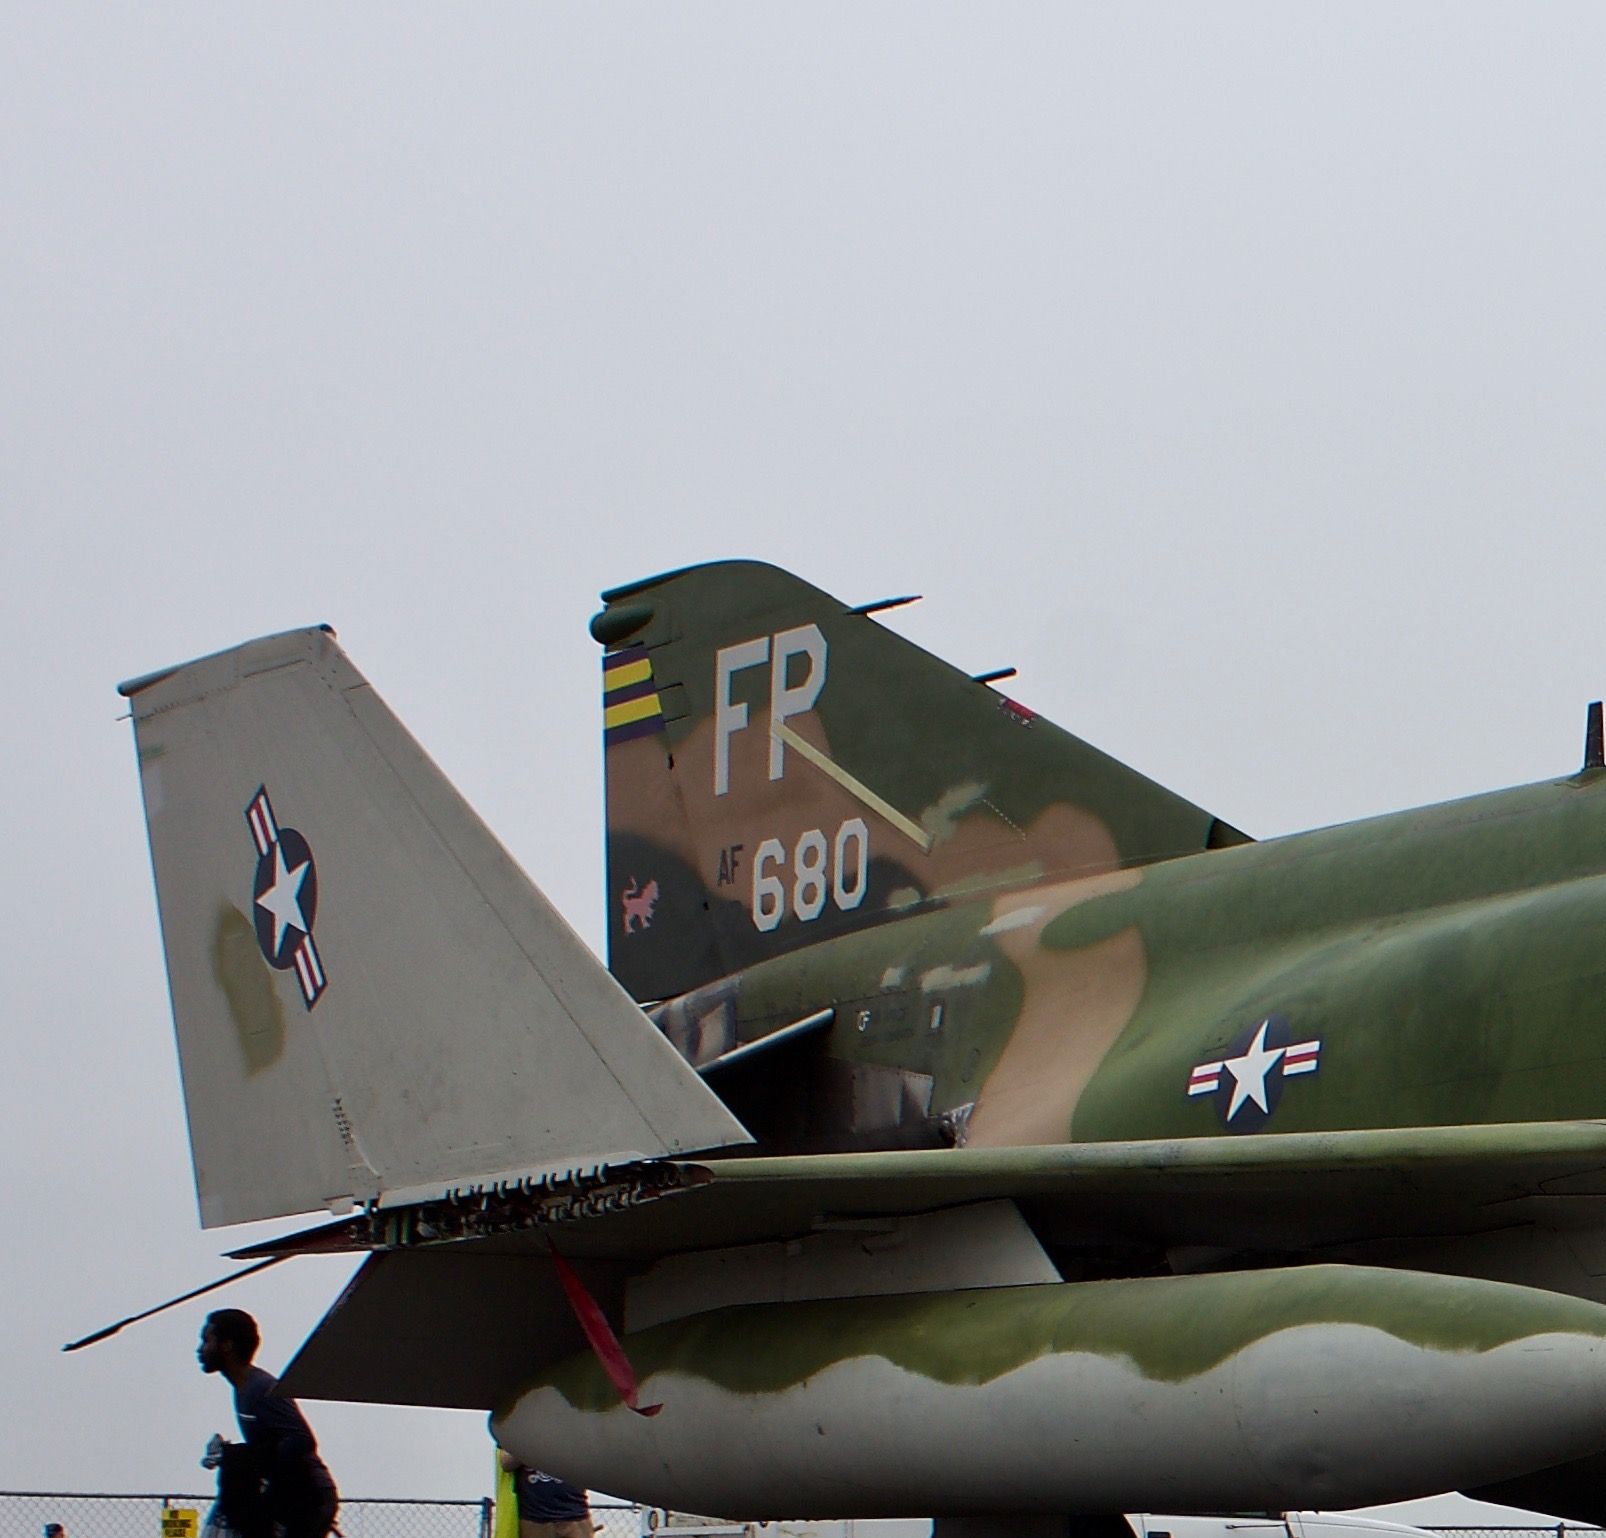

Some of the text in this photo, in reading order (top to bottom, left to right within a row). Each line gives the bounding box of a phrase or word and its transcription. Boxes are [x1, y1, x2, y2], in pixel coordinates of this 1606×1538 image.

[715, 624, 827, 796] FP
[717, 845, 743, 887] AF
[752, 817, 868, 933] 680
